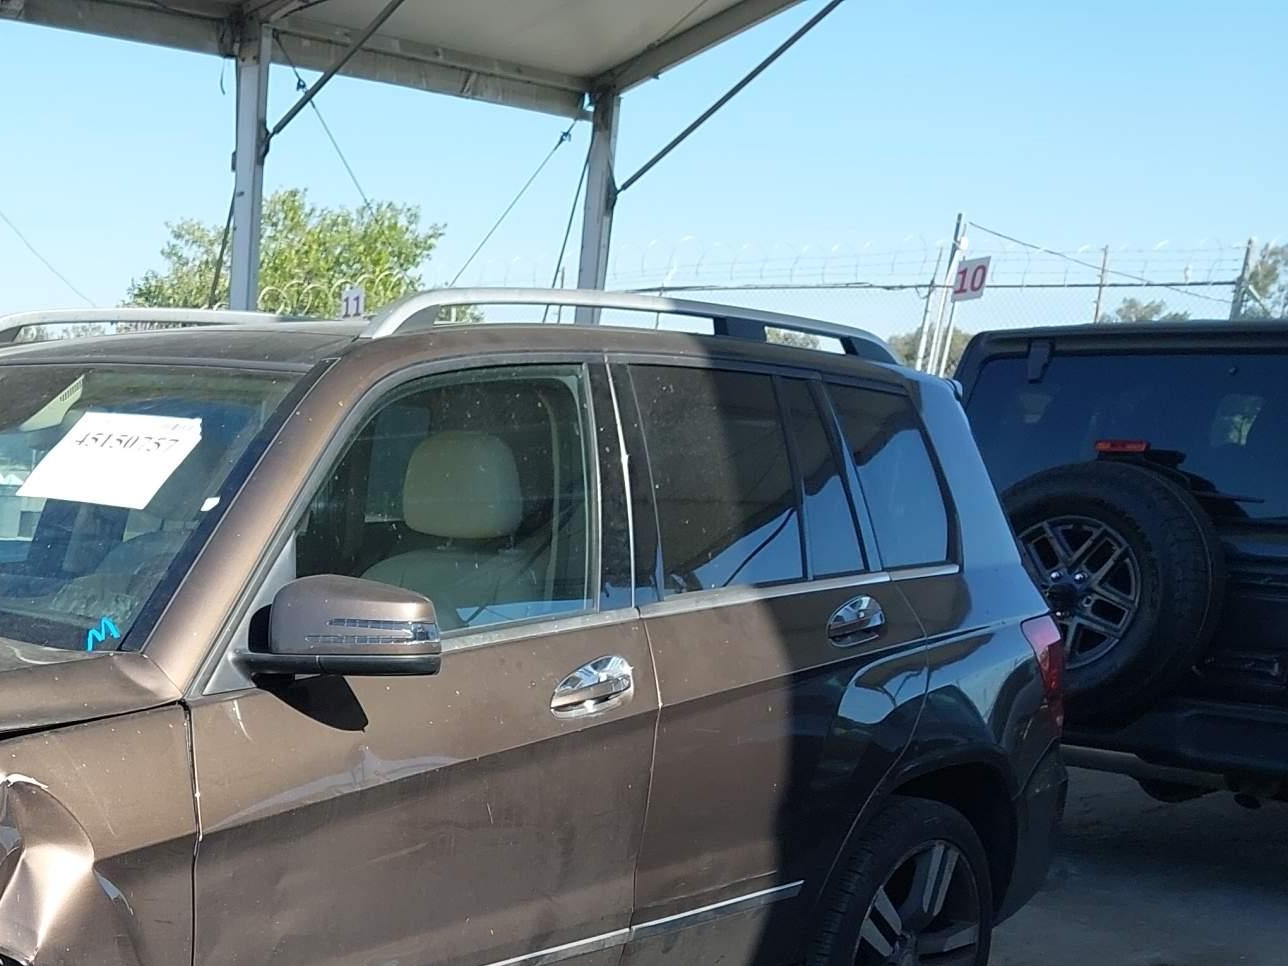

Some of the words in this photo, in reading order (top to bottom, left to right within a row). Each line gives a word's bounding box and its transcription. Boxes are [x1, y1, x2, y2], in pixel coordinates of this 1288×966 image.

[953, 264, 987, 294] 10
[342, 295, 361, 319] 11
[87, 616, 121, 652] M
